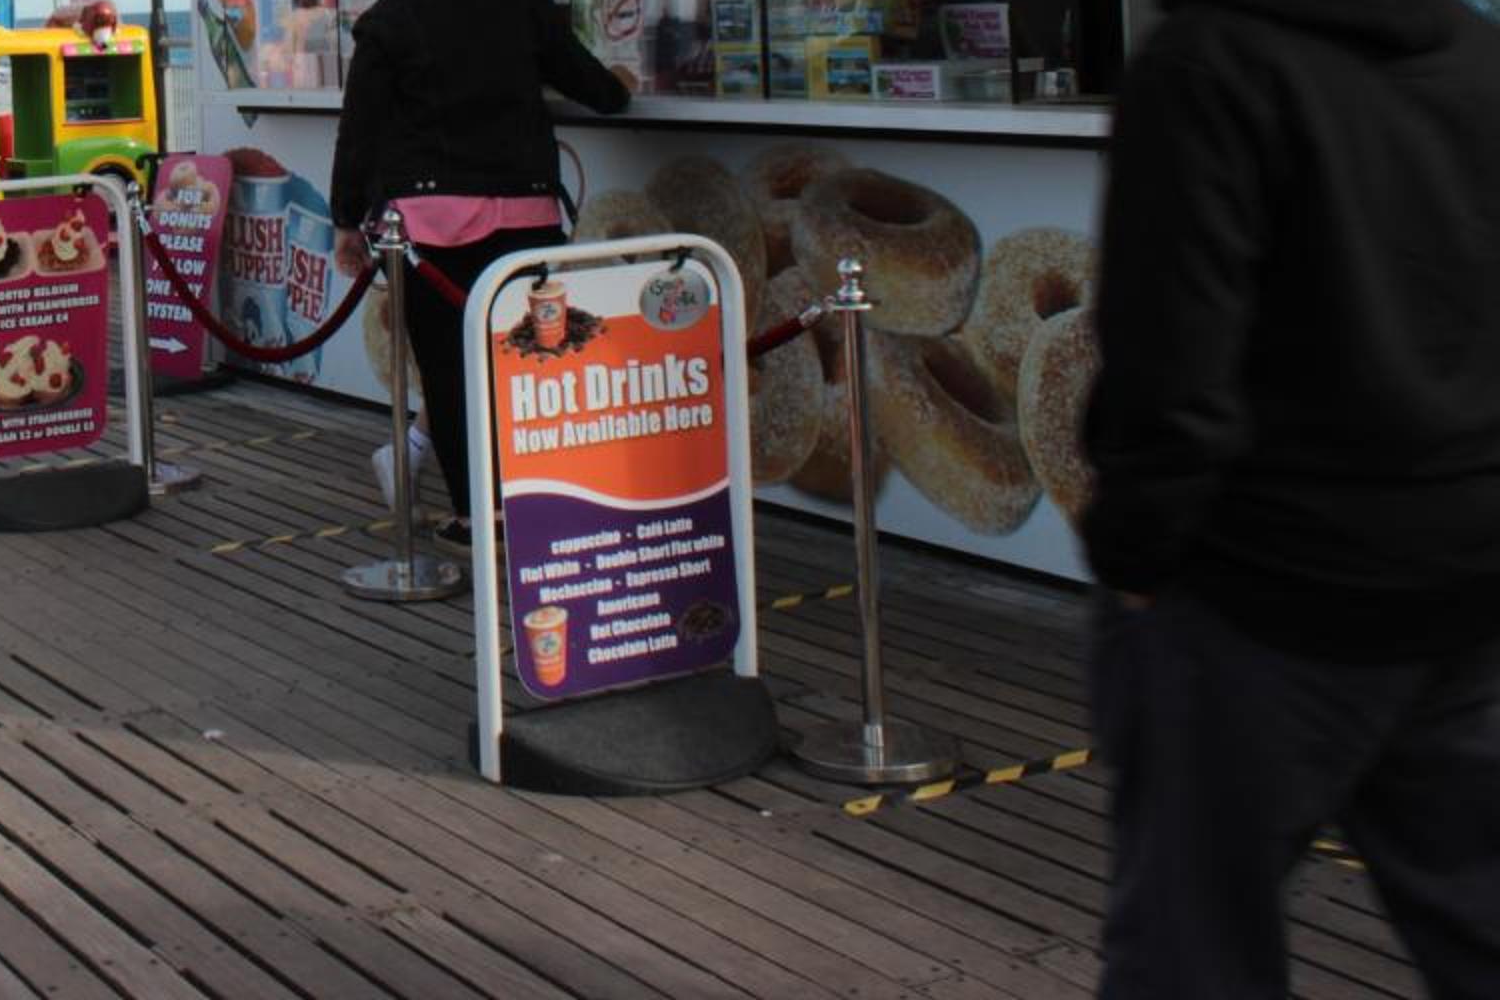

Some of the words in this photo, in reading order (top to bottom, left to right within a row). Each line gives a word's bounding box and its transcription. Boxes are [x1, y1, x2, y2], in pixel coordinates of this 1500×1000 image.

[176, 188, 204, 204] FOR
[158, 212, 213, 230] DONUTS
[158, 233, 205, 253] PLEASE
[231, 215, 284, 253] LUSH
[19, 314, 53, 328] CREAM
[146, 302, 194, 323] SYSTEM
[510, 371, 579, 423] Hot
[584, 353, 709, 412] Drinks
[512, 426, 559, 456] Now
[562, 410, 661, 448] Available
[663, 403, 713, 432] Here
[664, 517, 693, 537] Latte
[519, 566, 544, 585] Flat
[595, 550, 638, 571] Double
[679, 558, 712, 578] Short
[597, 592, 661, 616] Americano
[589, 622, 612, 641] Hot
[611, 611, 671, 637] Chocolate
[587, 639, 649, 665] Chocolate
